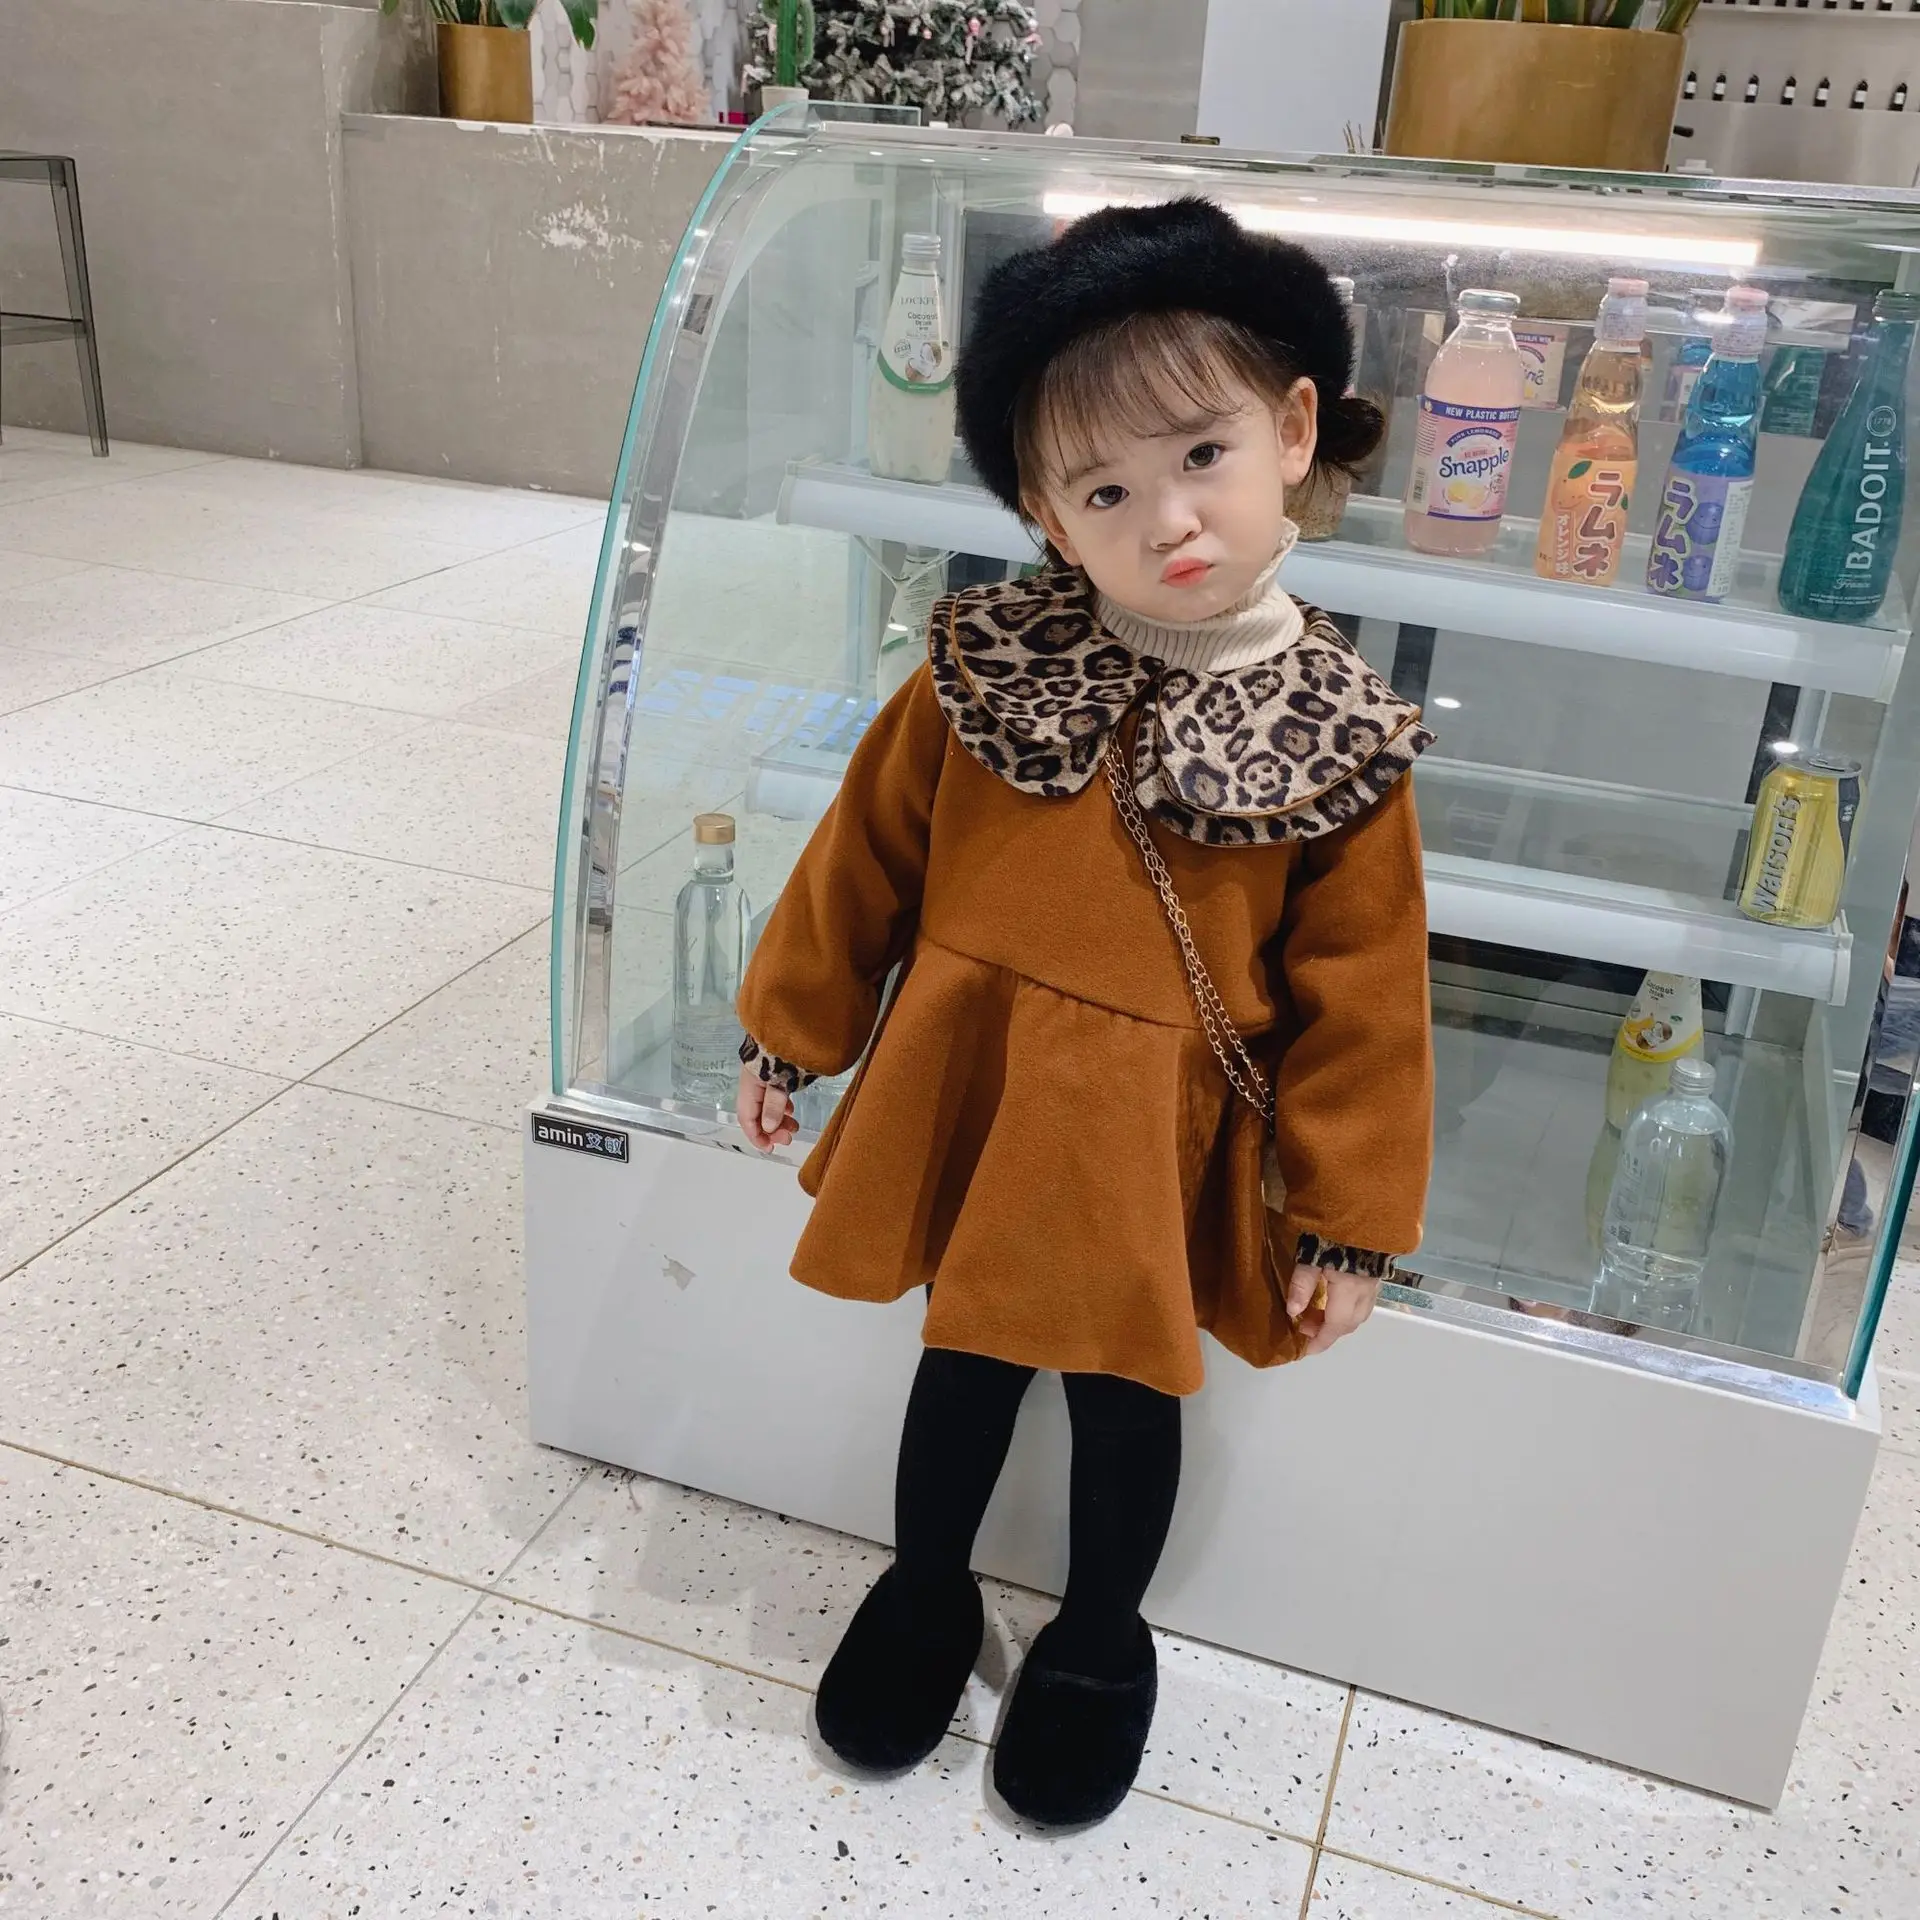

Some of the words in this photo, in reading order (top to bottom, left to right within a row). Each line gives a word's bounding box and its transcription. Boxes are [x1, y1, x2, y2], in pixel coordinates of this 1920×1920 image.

[1445, 406, 1463, 417] NEW
[1466, 410, 1497, 420] PLASTIC
[1439, 446, 1510, 478] Snapple
[1573, 472, 1623, 577] ラムネ
[1649, 480, 1695, 590] ラムネ
[538, 1125, 584, 1147] amin
